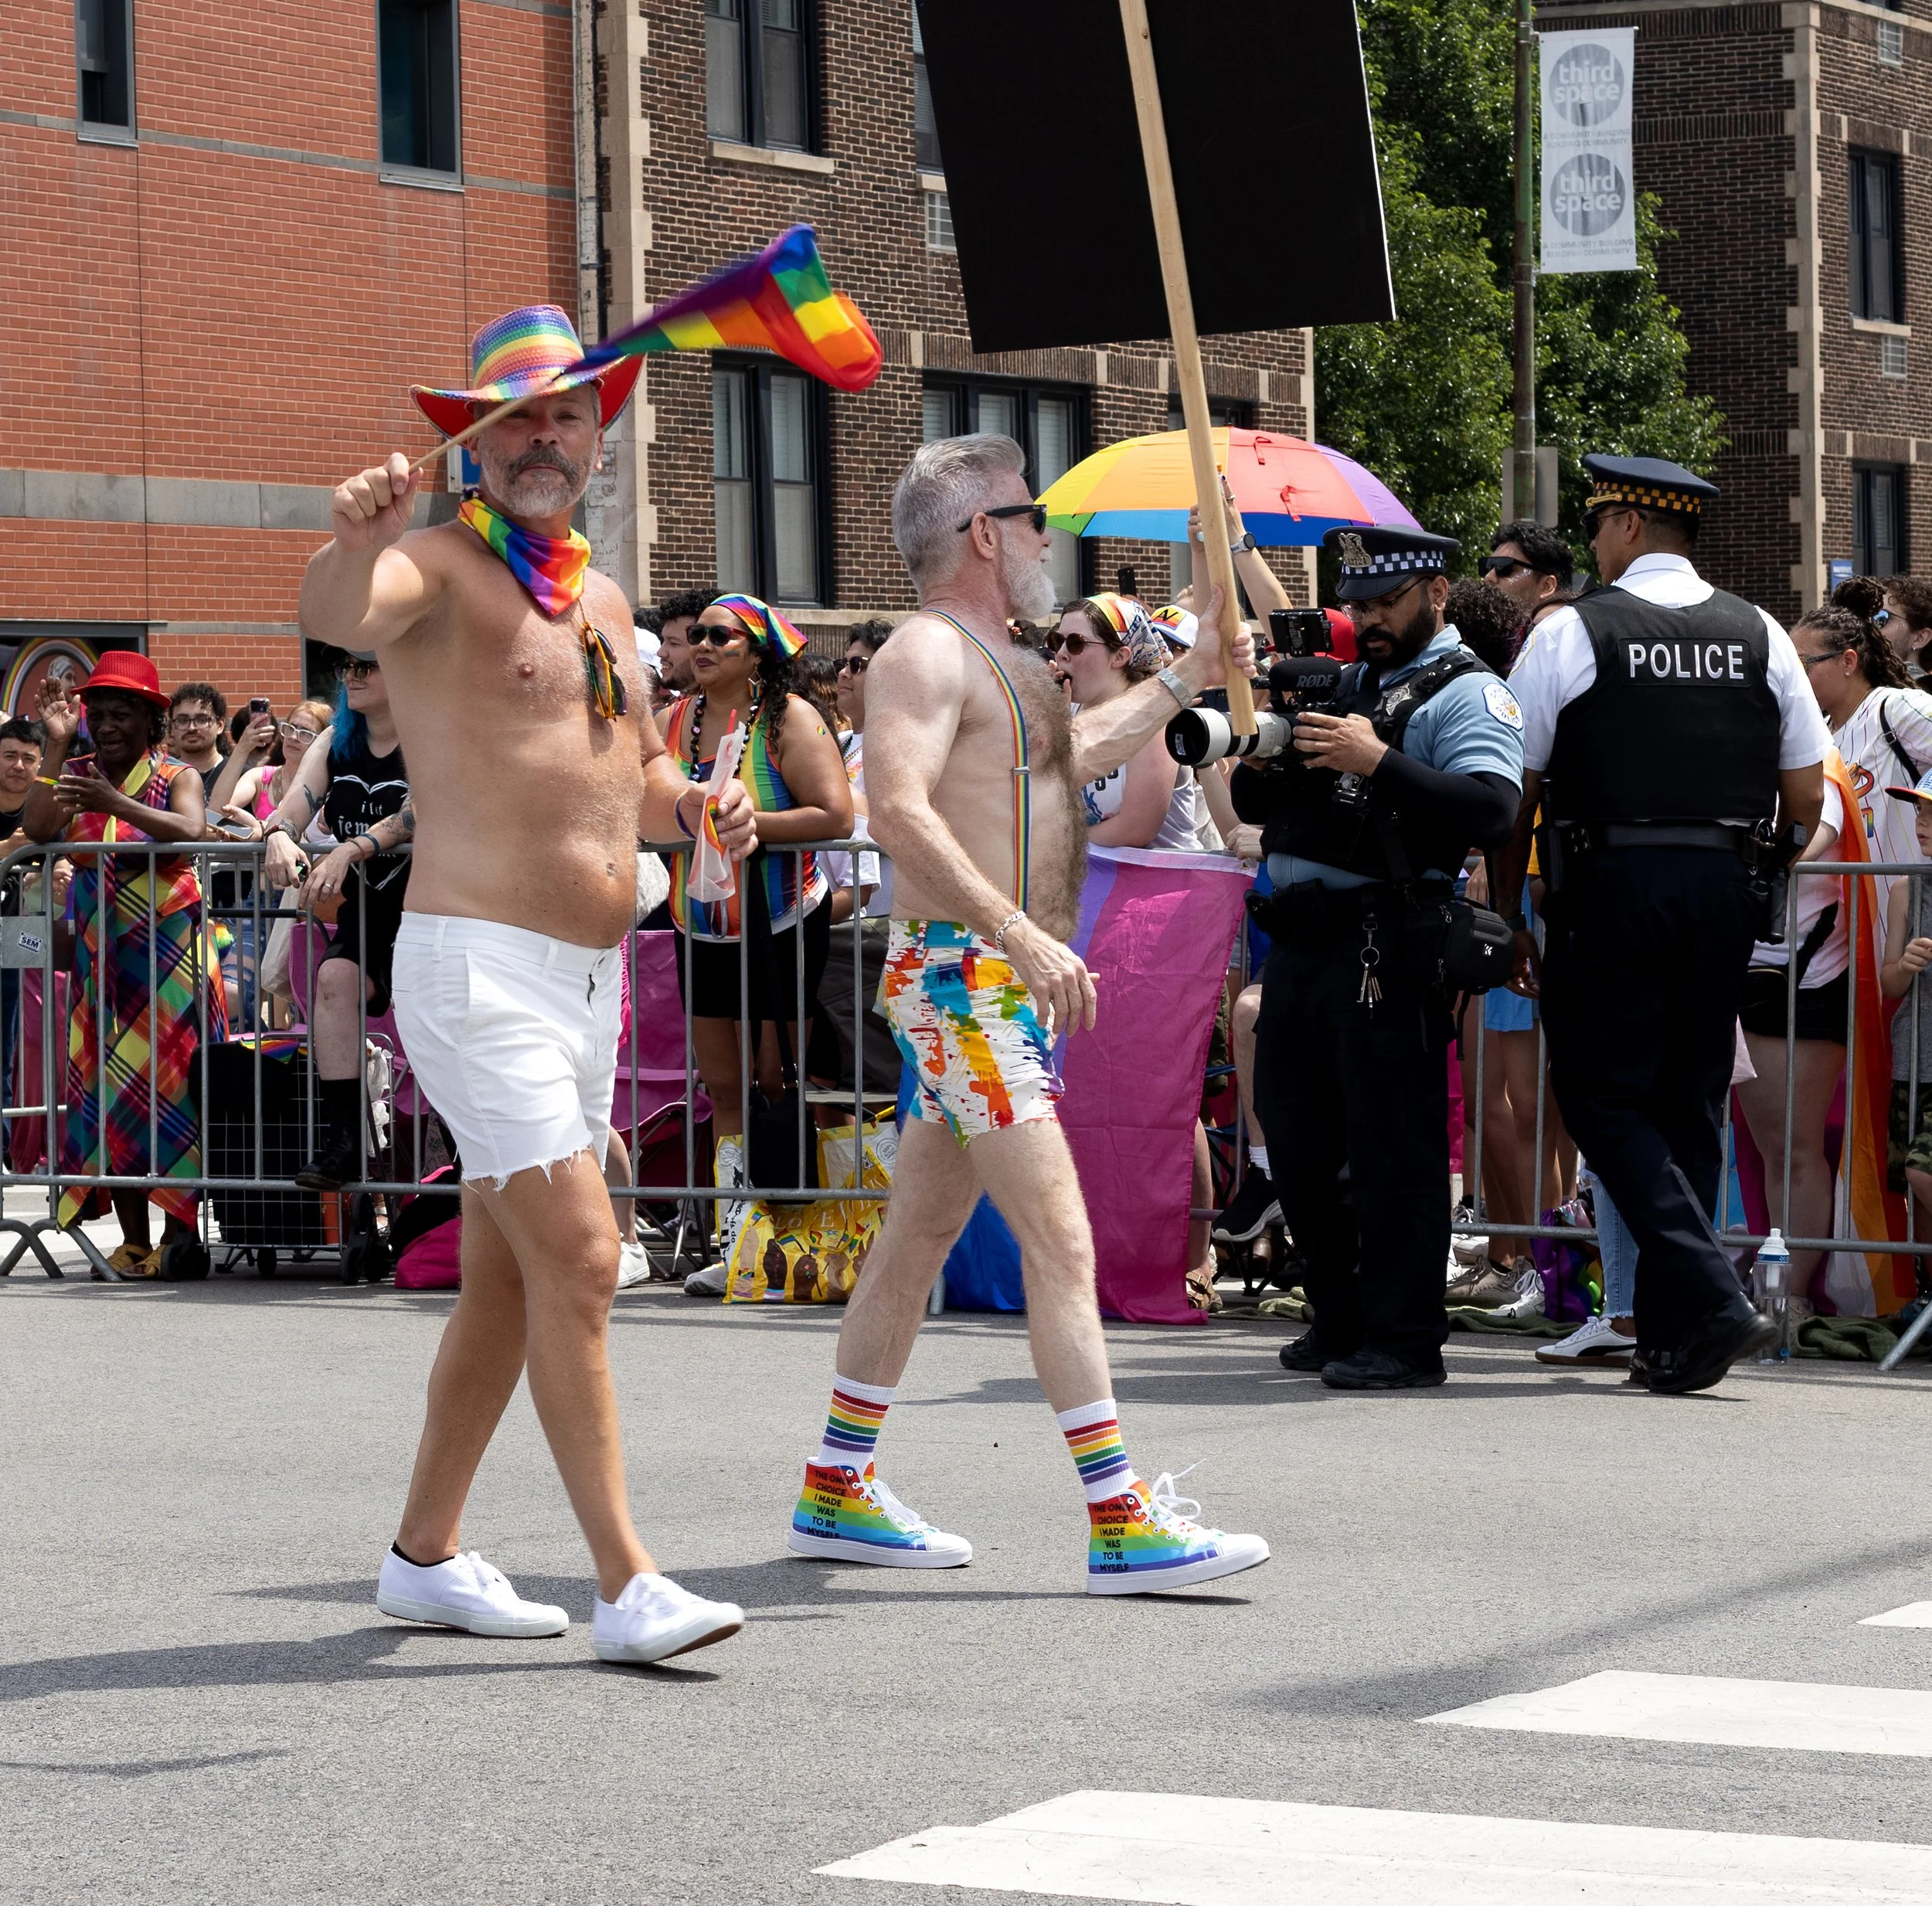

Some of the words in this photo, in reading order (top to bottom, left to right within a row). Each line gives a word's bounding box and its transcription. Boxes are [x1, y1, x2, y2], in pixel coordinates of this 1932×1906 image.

[1559, 50, 1615, 84] third
[1554, 82, 1621, 121] space
[1560, 161, 1616, 194] third
[1555, 193, 1621, 232] space
[1628, 643, 1743, 679] POLICE
[1296, 674, 1334, 687] RØDE
[21, 936, 39, 949] SEM
[775, 1209, 835, 1230] LOE
[815, 1470, 828, 1480] THE
[829, 1474, 852, 1485] ONLY
[816, 1483, 846, 1497] CHOICE
[818, 1494, 842, 1507] MADE
[816, 1506, 836, 1517] WAS
[1093, 1504, 1106, 1513] THE
[1108, 1503, 1131, 1512] ONLY
[812, 1516, 824, 1526] TO
[825, 1520, 837, 1529] BE
[1097, 1515, 1128, 1524] CHOICE
[807, 1527, 840, 1539] MYSELF
[1103, 1527, 1125, 1536] MADE
[1105, 1539, 1121, 1548] WAS
[1103, 1551, 1114, 1560] TO
[1115, 1551, 1124, 1560] BE
[1100, 1564, 1130, 1572] MYSELF
